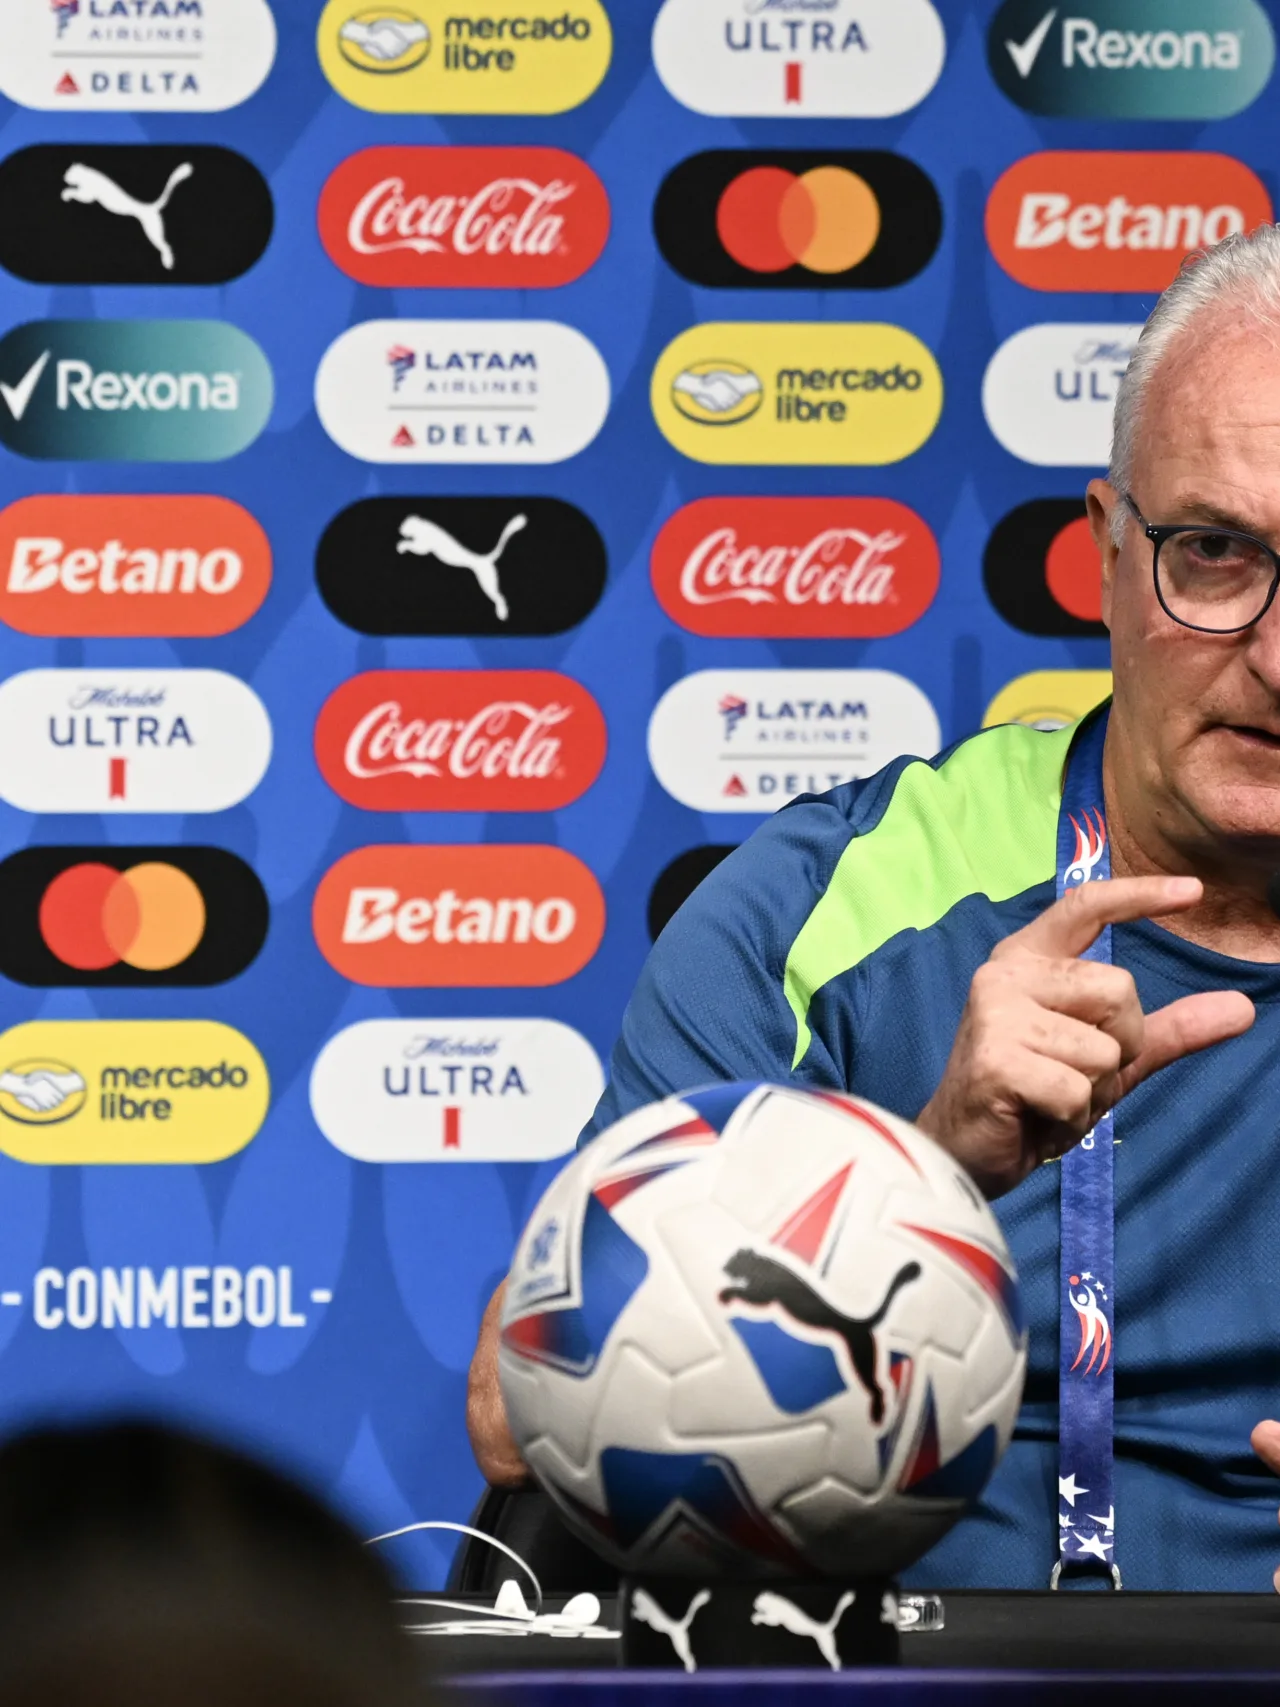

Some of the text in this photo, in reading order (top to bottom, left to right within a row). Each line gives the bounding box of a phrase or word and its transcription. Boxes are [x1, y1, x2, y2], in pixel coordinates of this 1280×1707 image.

[90, 0, 202, 17] LATAM
[90, 27, 202, 41] AIRLINES
[445, 14, 591, 40] mercado
[725, 20, 867, 51] ULTRA
[1063, 18, 1237, 68] Rexona
[445, 45, 515, 71] libre
[92, 72, 198, 93] DELTA
[1017, 194, 1244, 250] Betano
[426, 353, 536, 370] LATAM
[57, 360, 235, 410] Rexona
[426, 381, 537, 393] AIRLINES
[777, 365, 922, 391] mercado
[777, 396, 846, 422] libre
[427, 425, 533, 445] DELTA
[7, 538, 241, 593] Betano
[757, 701, 867, 719] LATAM
[50, 716, 193, 746] ULTRA
[758, 729, 868, 743] AIRLINES
[757, 773, 860, 796] DELT
[343, 888, 575, 943] Betano
[101, 1062, 248, 1088] mercado
[384, 1065, 527, 1096] ULTRA
[101, 1094, 171, 1120] libre
